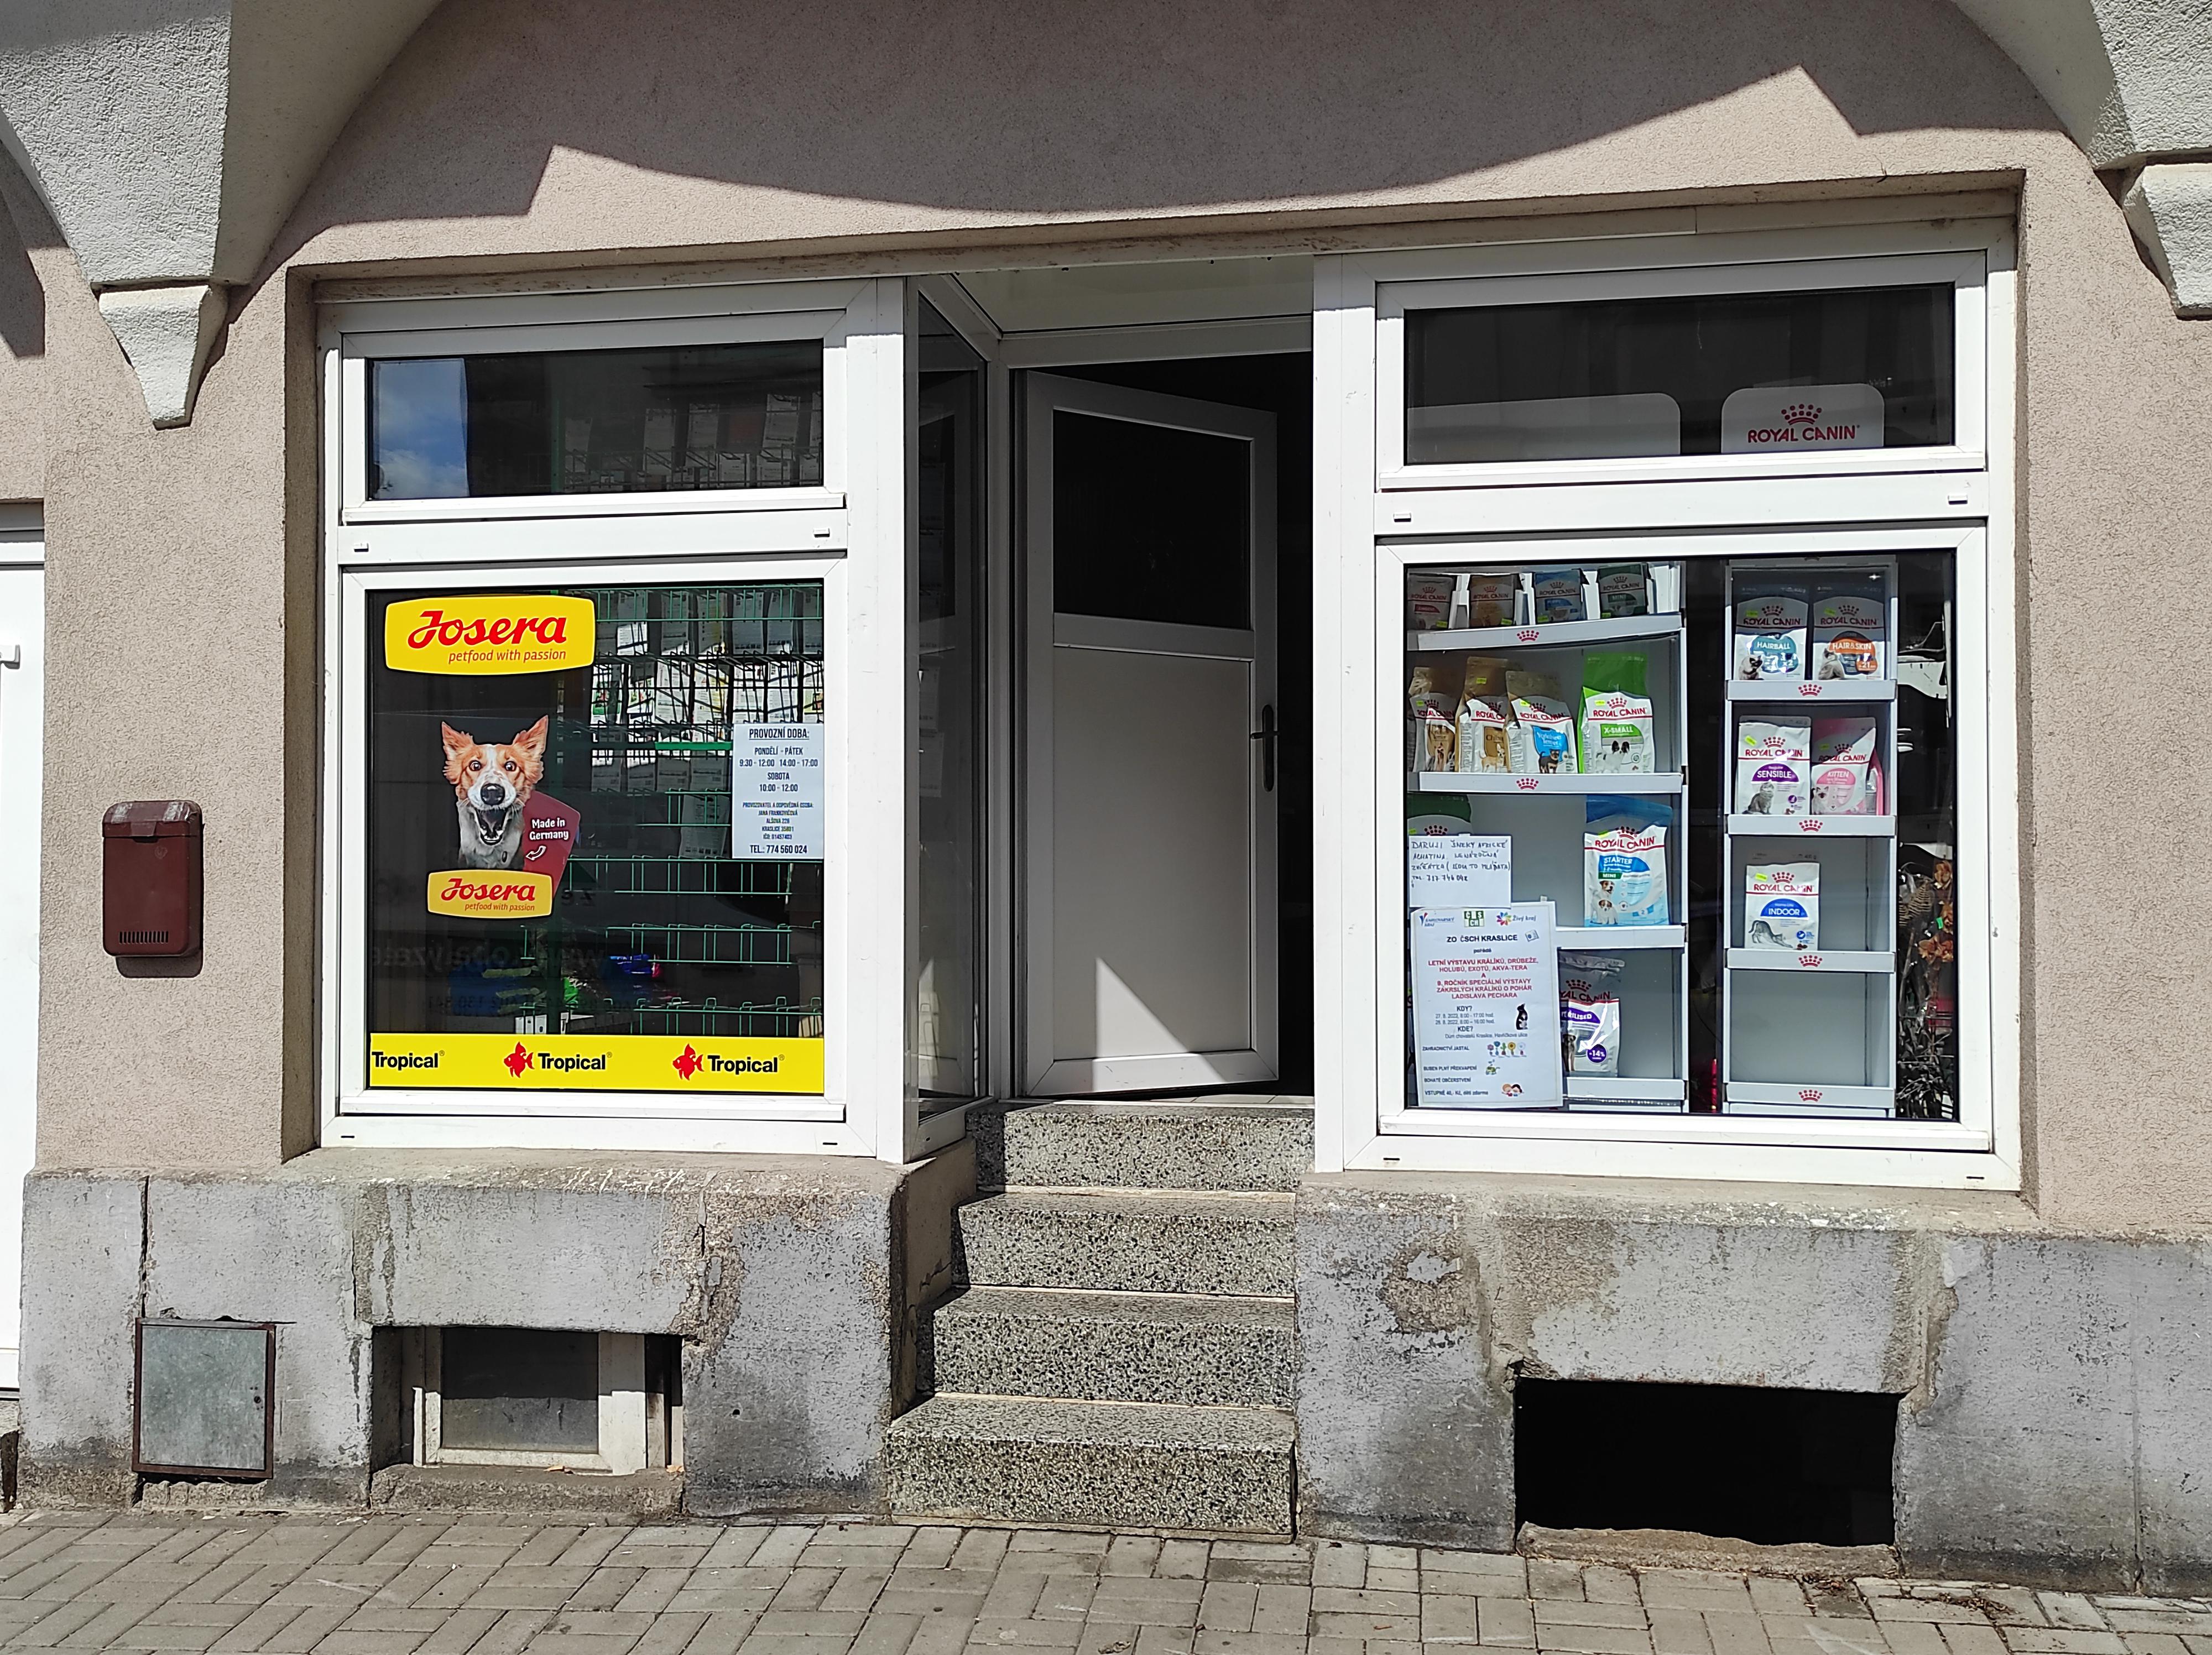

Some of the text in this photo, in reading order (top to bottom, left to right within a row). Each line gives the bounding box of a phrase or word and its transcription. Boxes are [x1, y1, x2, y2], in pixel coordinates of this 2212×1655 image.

[1747, 425, 1856, 443] ROYAL CANIN
[408, 610, 567, 649] Josera
[448, 648, 566, 665] petfood with passion
[1476, 711, 1496, 719] ROYAL
[1619, 707, 1646, 716] CANIN
[749, 726, 810, 738] PROVOZNÍ DOBA:
[1604, 725, 1634, 734] X-SMALL
[754, 745, 803, 755] PONDĚLÍ PÁTEK
[758, 759, 775, 767] 12:00
[779, 759, 796, 767] 14:00
[801, 759, 818, 767] 17:00
[767, 772, 790, 780] SOBOTA
[1756, 770, 1792, 779] SENSIBLE
[759, 784, 798, 792] 10:00 12:00
[531, 817, 565, 829] Made in
[529, 830, 569, 840] Germany
[1595, 836, 1655, 849] ROYAL CANIN
[766, 844, 779, 853] 774
[780, 844, 793, 853] 560
[795, 844, 807, 853] 024
[440, 878, 535, 901] Josera
[1754, 884, 1782, 892] ROYAL
[465, 902, 492, 911] petfood
[509, 902, 535, 912] passion
[1437, 985, 1474, 993] ZÁKRSLÝCH
[1560, 990, 1577, 999] YAL
[372, 1051, 439, 1071] Tropical
[538, 1053, 606, 1072] Tropical
[707, 1054, 778, 1075] Tropical
